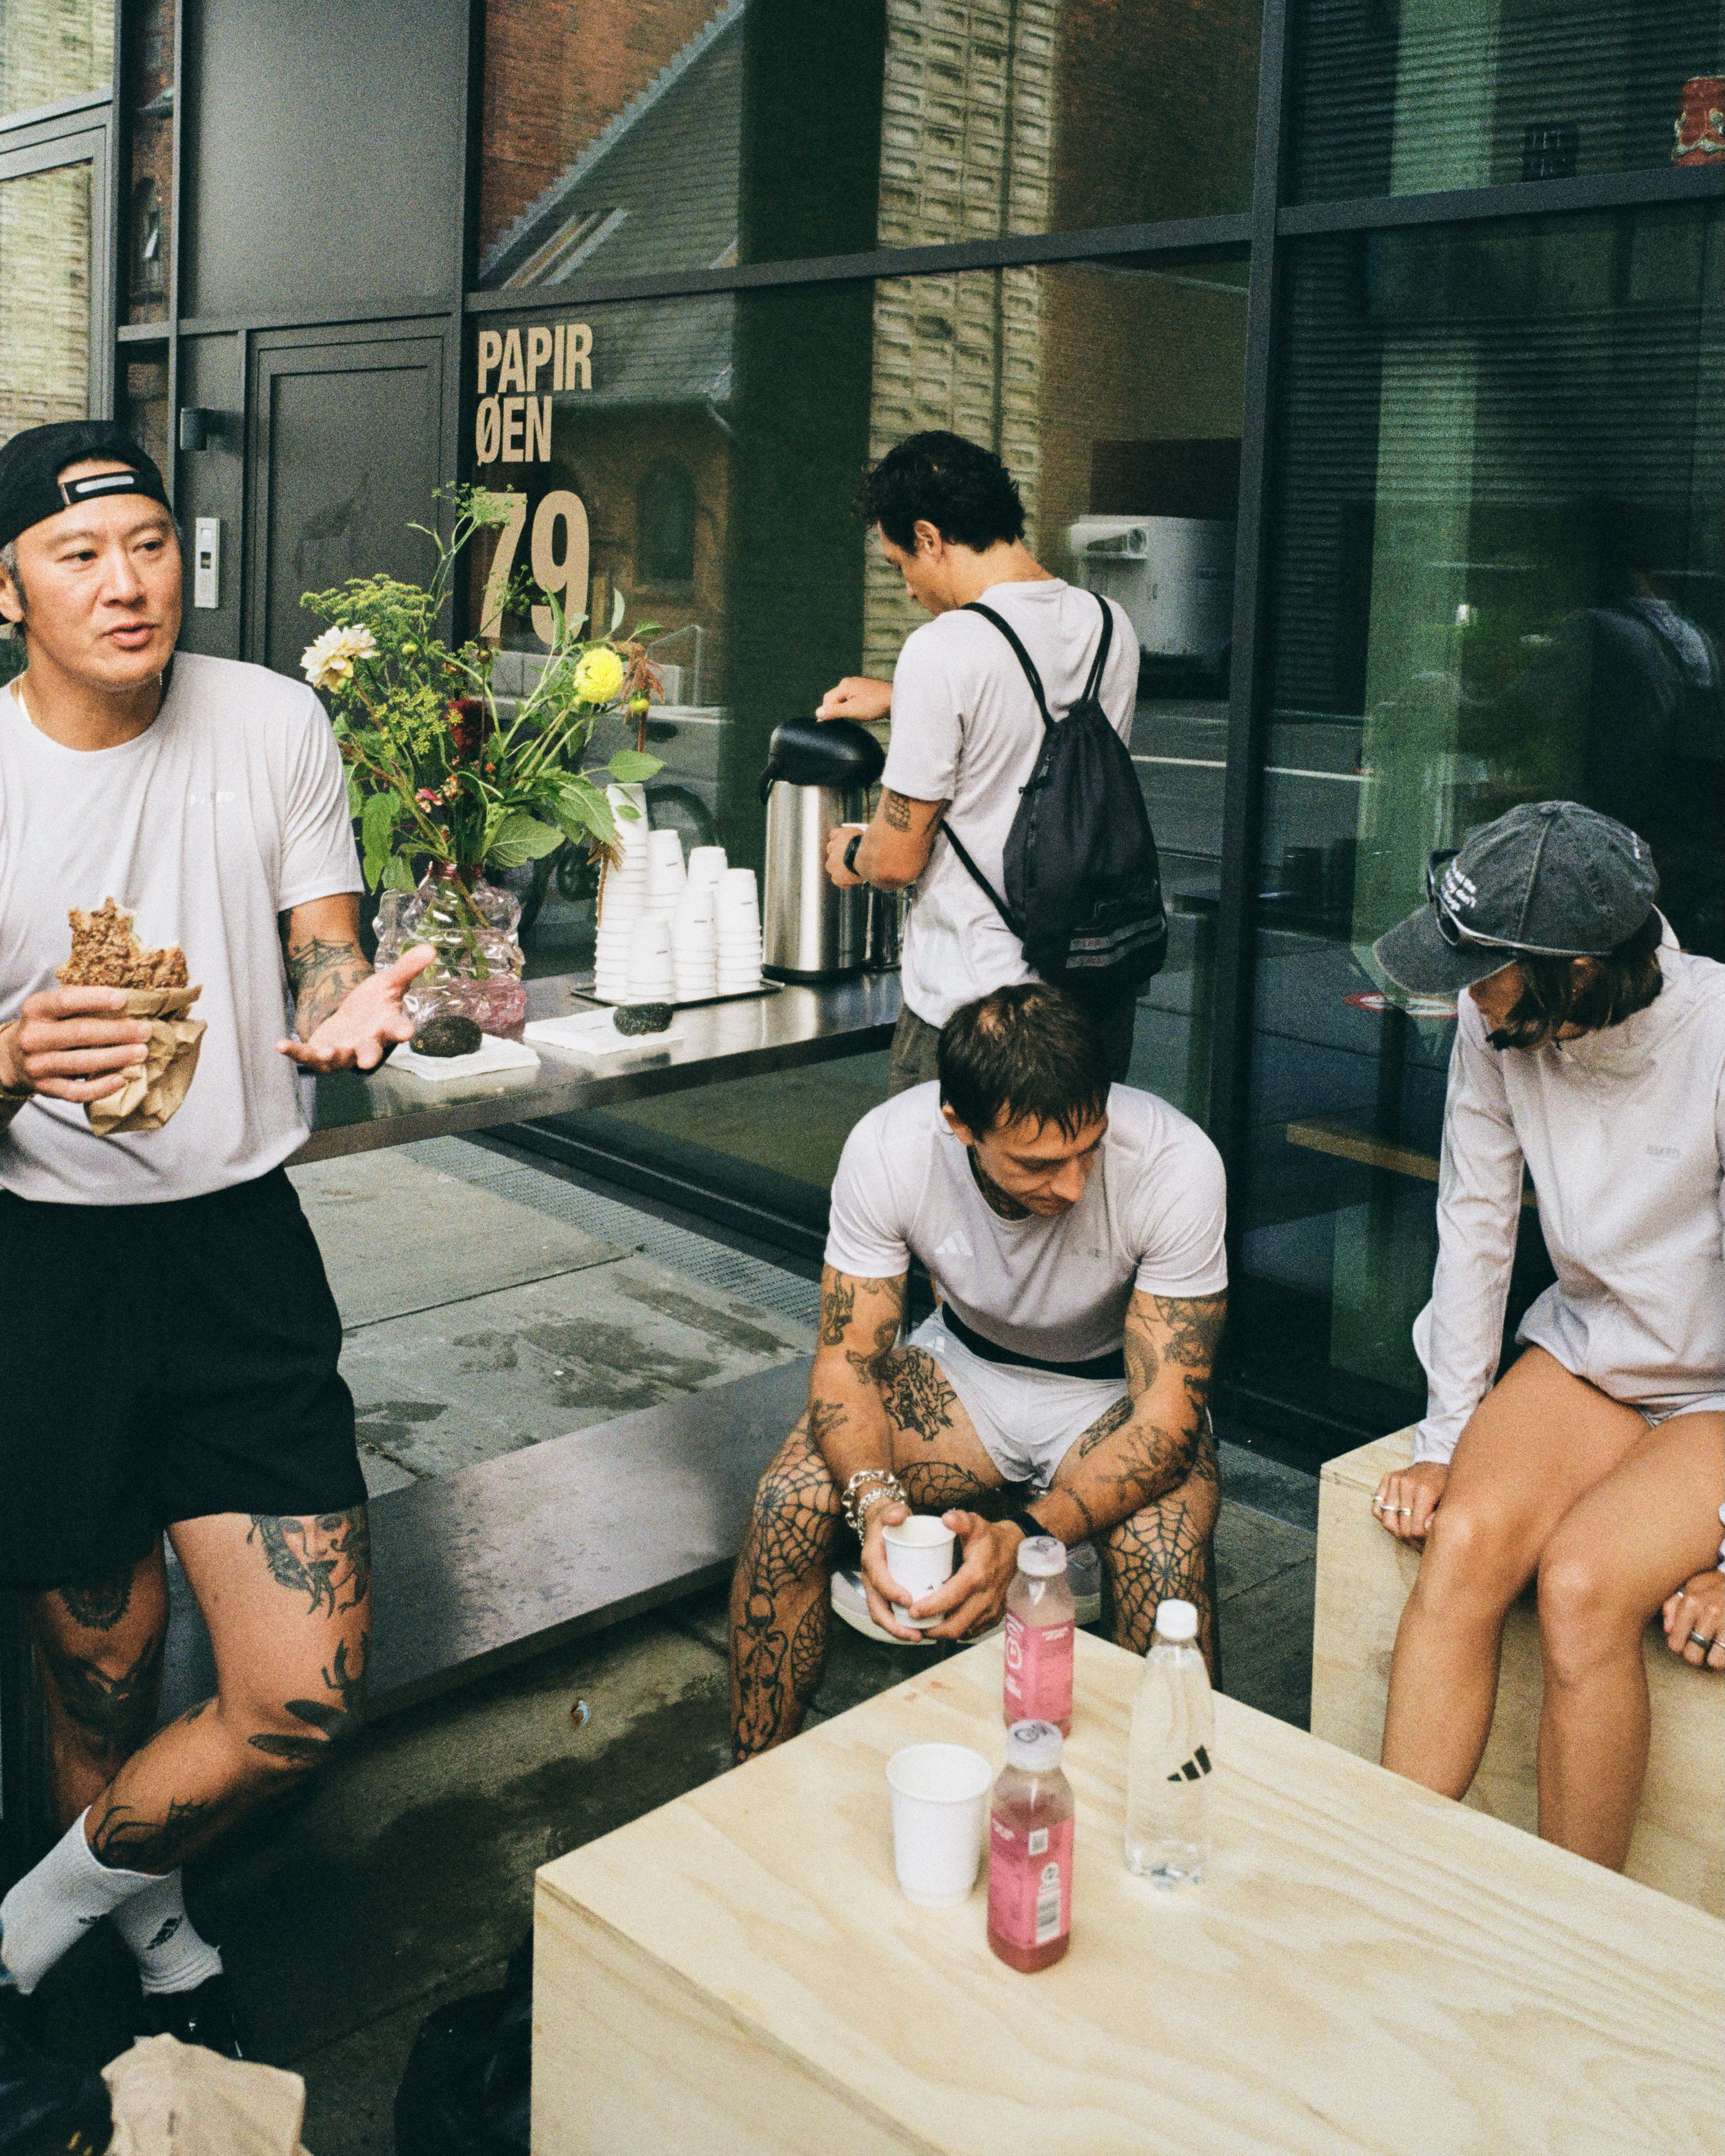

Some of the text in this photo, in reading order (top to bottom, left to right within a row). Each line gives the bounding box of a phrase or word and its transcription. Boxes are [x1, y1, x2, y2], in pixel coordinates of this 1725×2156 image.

[478, 323, 593, 394] PAPIR
[476, 393, 552, 466] ØEN
[478, 490, 590, 645] 79
